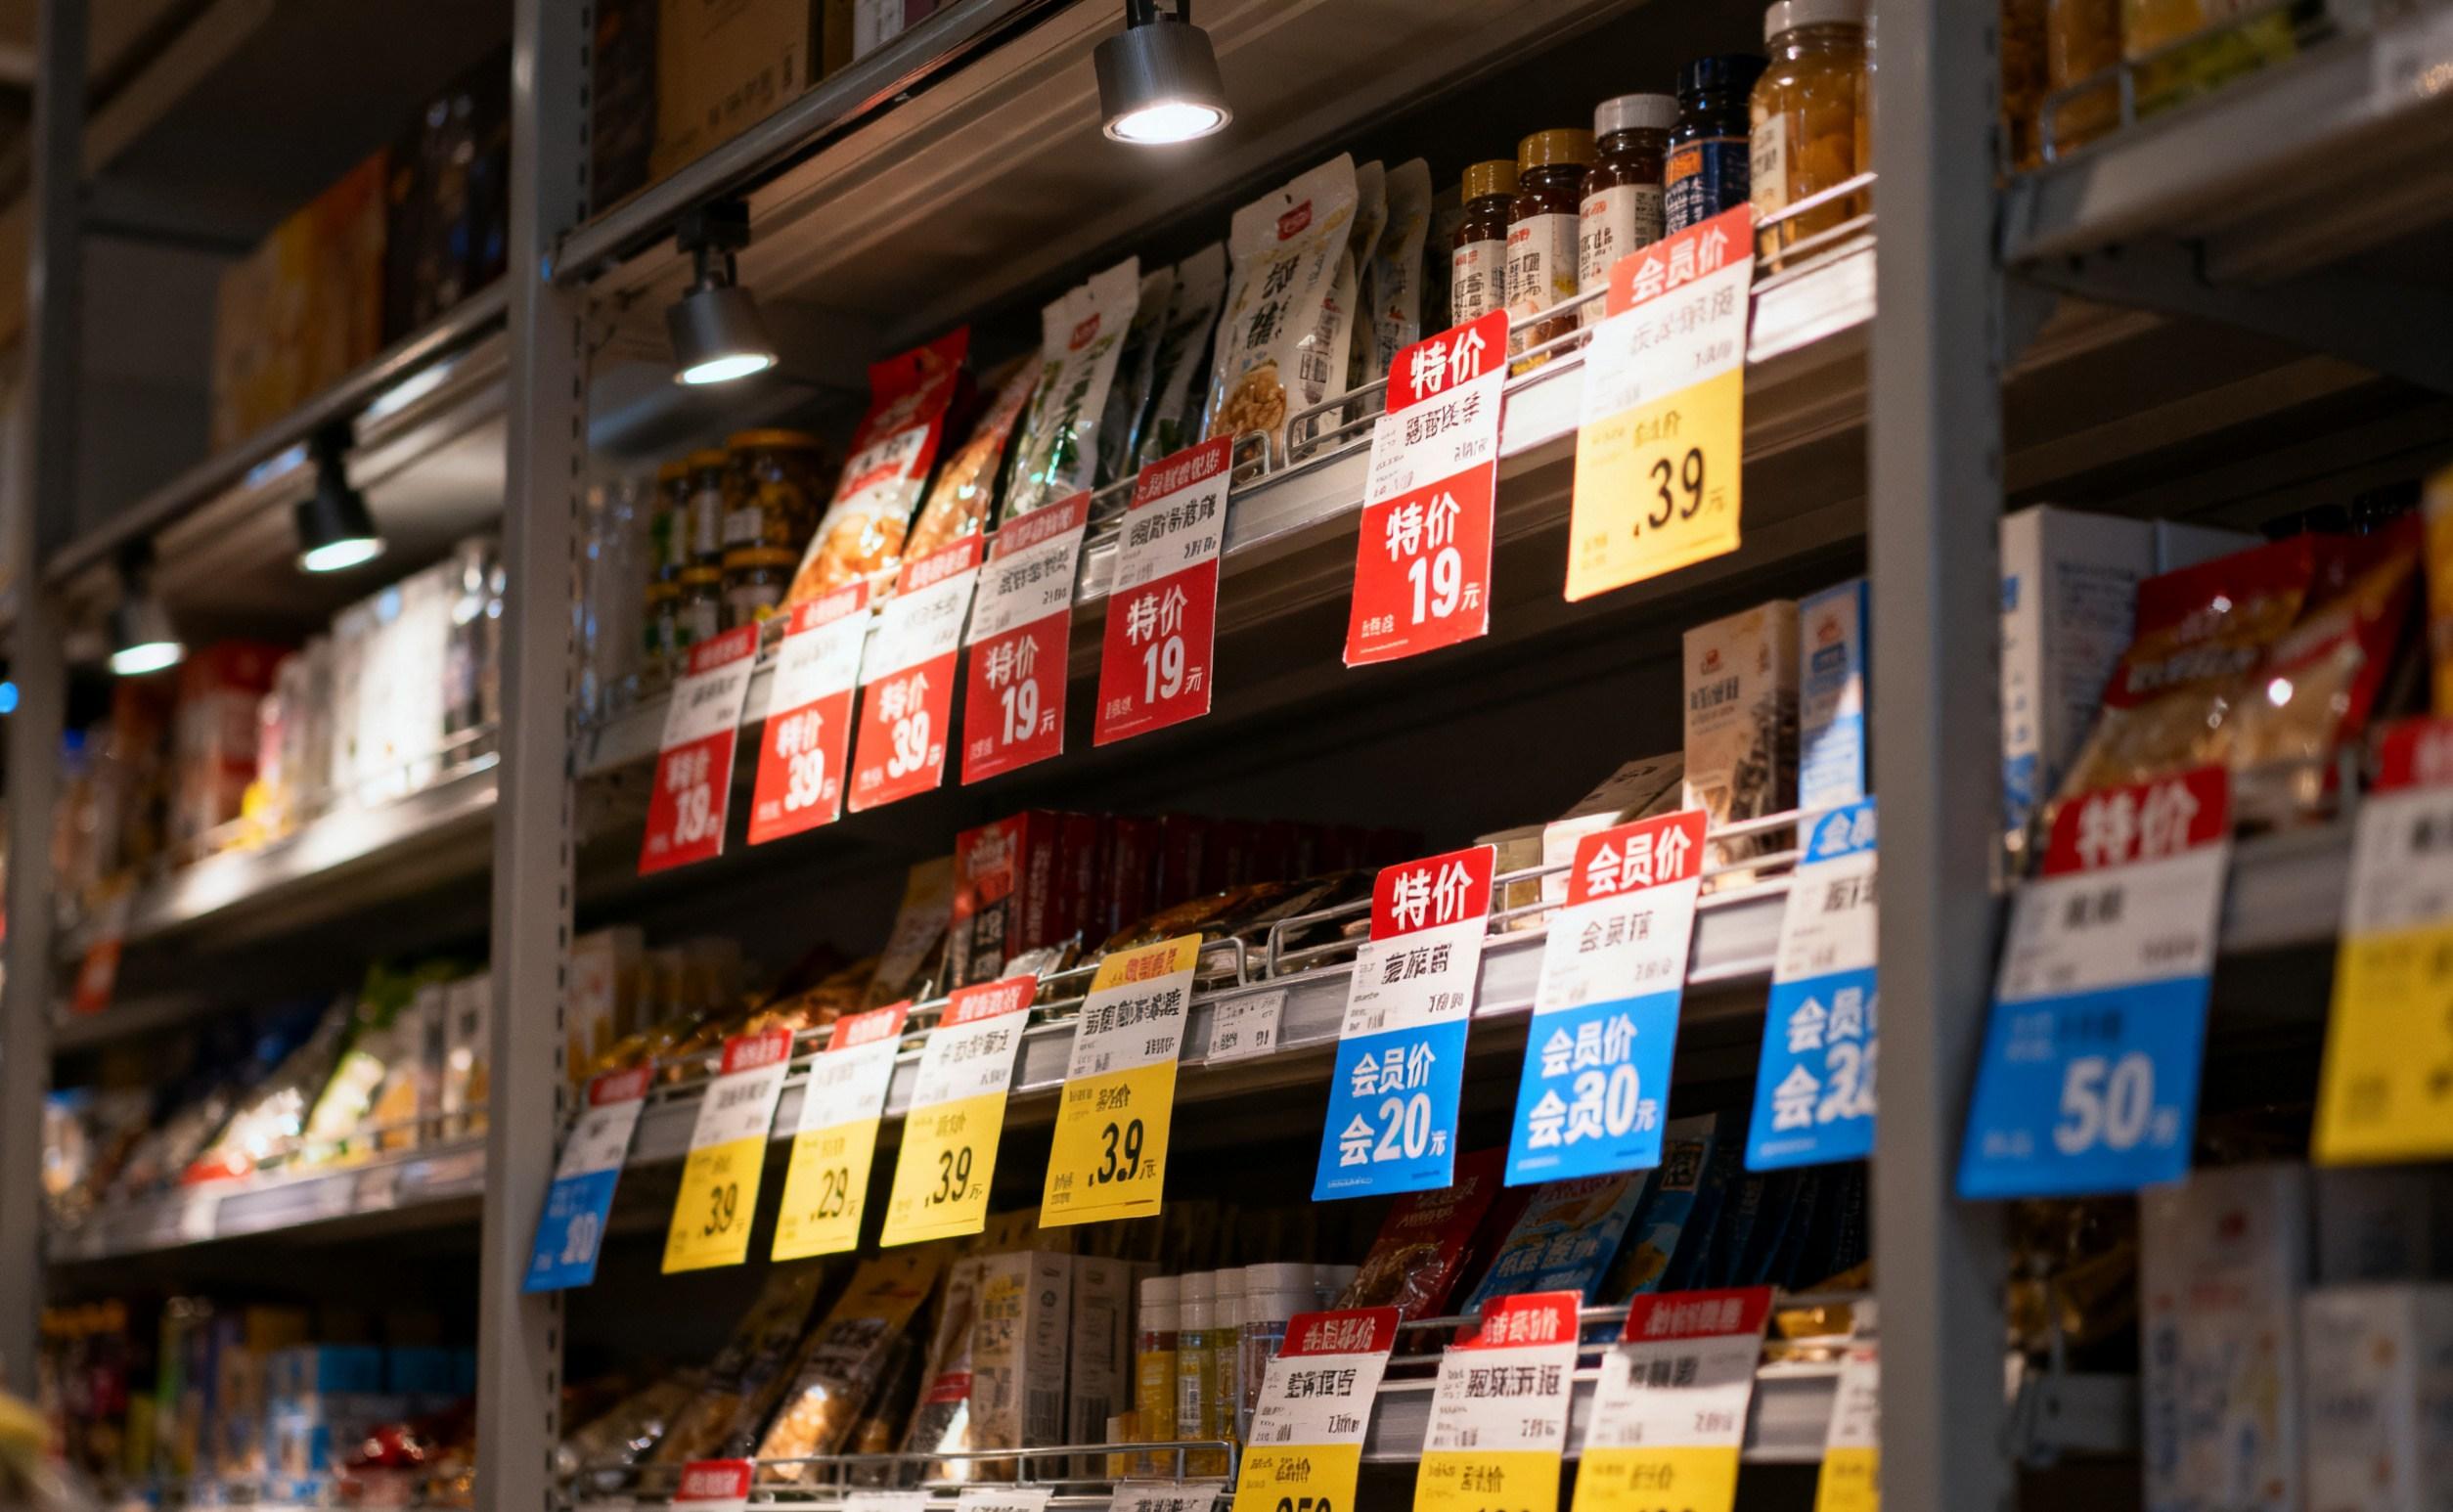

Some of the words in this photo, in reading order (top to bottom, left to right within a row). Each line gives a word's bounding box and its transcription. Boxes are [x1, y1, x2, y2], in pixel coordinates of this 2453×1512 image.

[1410, 327, 1486, 399] 特价
[1385, 491, 1461, 562] 特价
[1127, 584, 1189, 646] 特价
[1586, 823, 1692, 898] 会员价
[1391, 861, 1474, 931] 特价
[1540, 1012, 1639, 1080] 会员价
[1786, 986, 1877, 1054] 会员
[1351, 1040, 1437, 1099] 会员价
